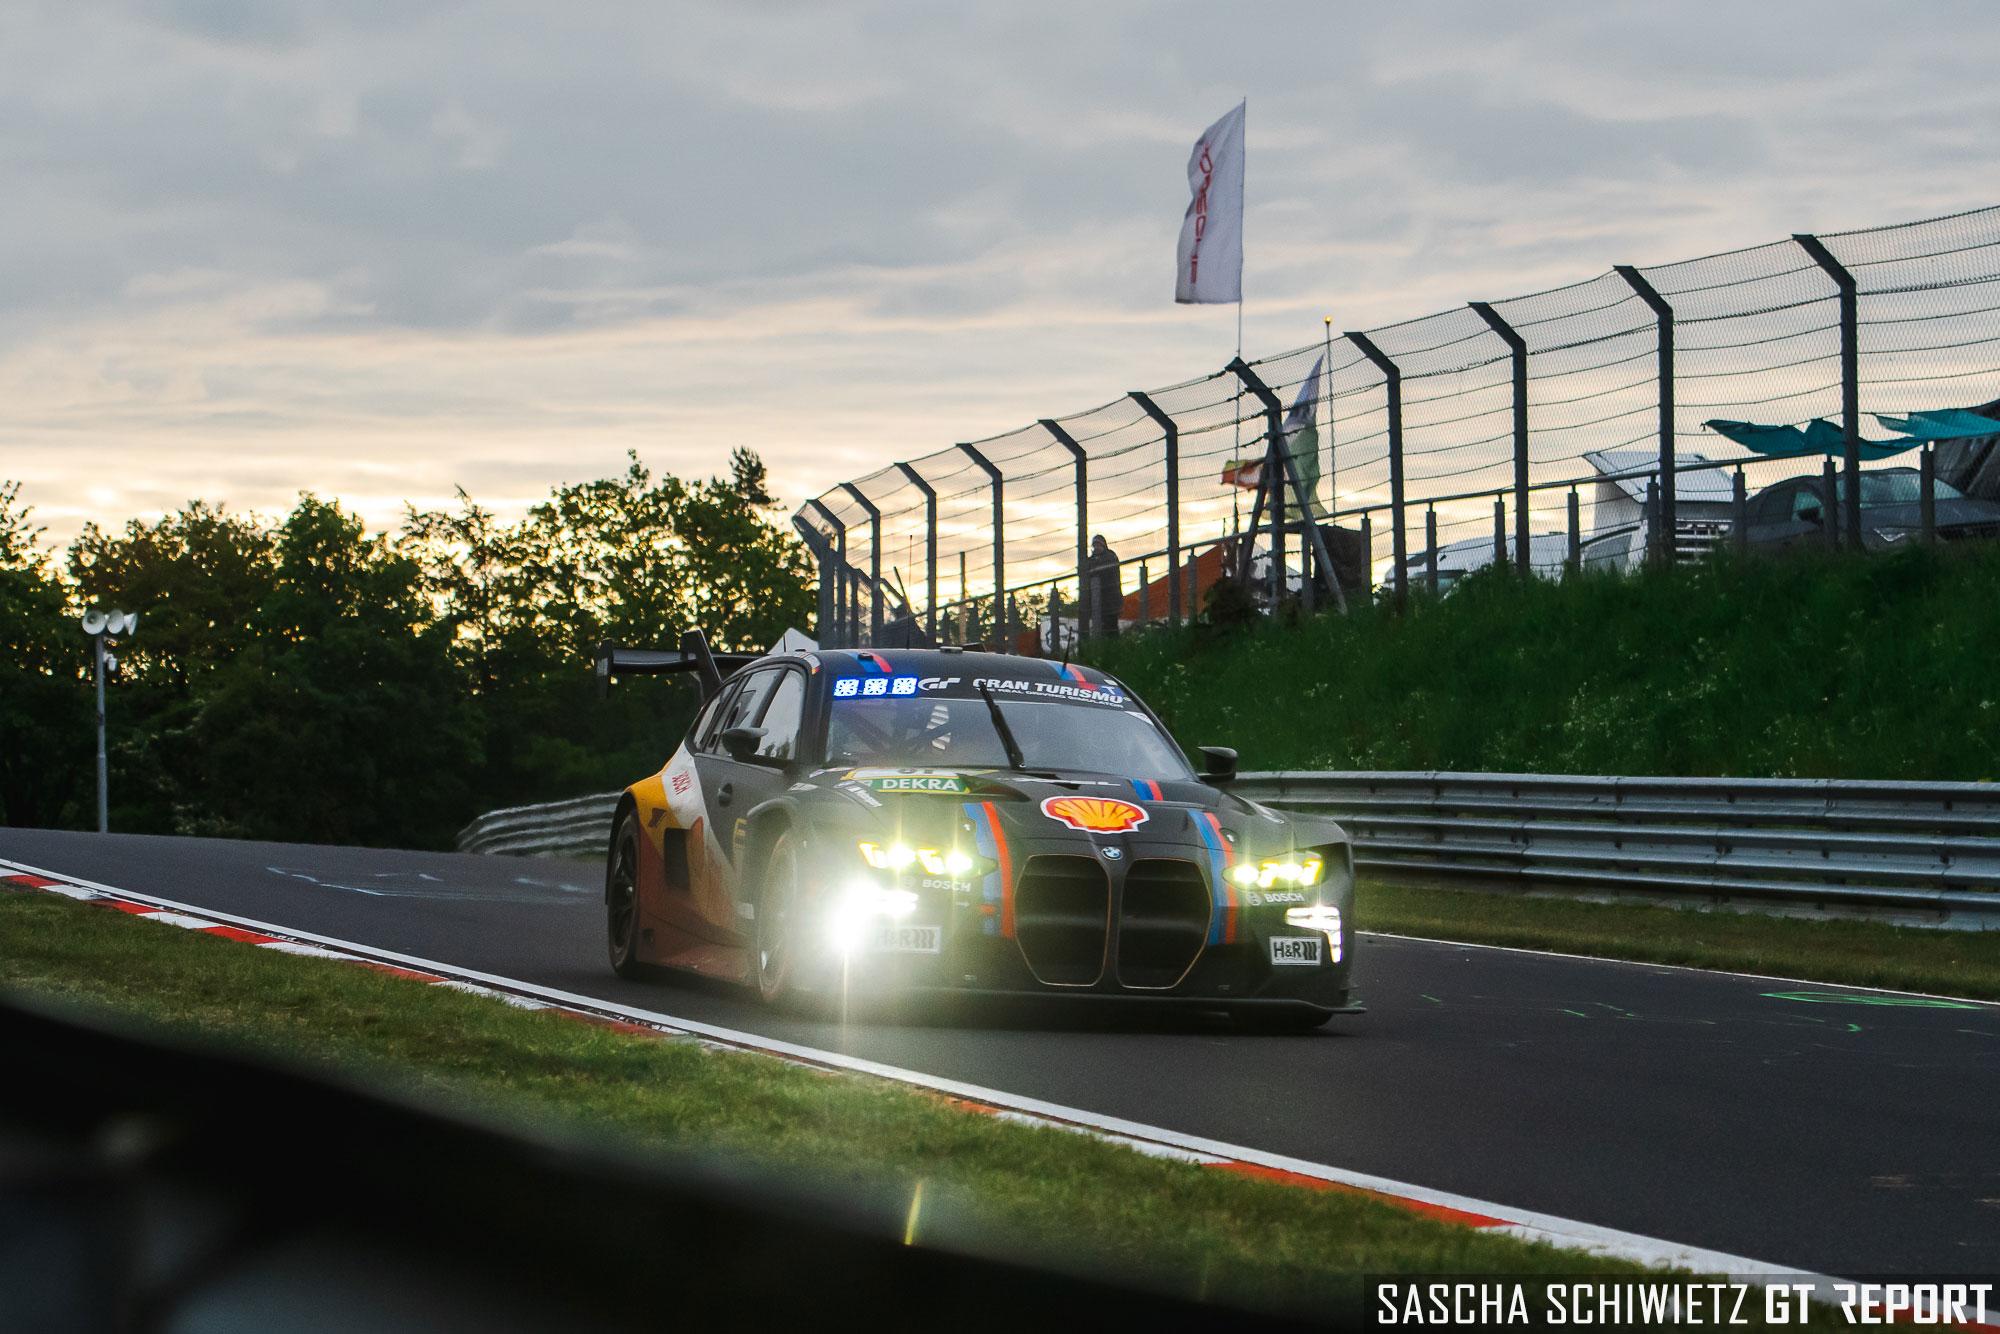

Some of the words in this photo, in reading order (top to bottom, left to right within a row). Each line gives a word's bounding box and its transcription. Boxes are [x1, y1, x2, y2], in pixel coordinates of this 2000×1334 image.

[972, 678, 1030, 691] GRAN
[1034, 682, 1124, 704] TURISMO
[882, 778, 960, 791] DEKRA
[922, 879, 972, 892] BOSCH
[1263, 892, 1305, 903] BOSCH
